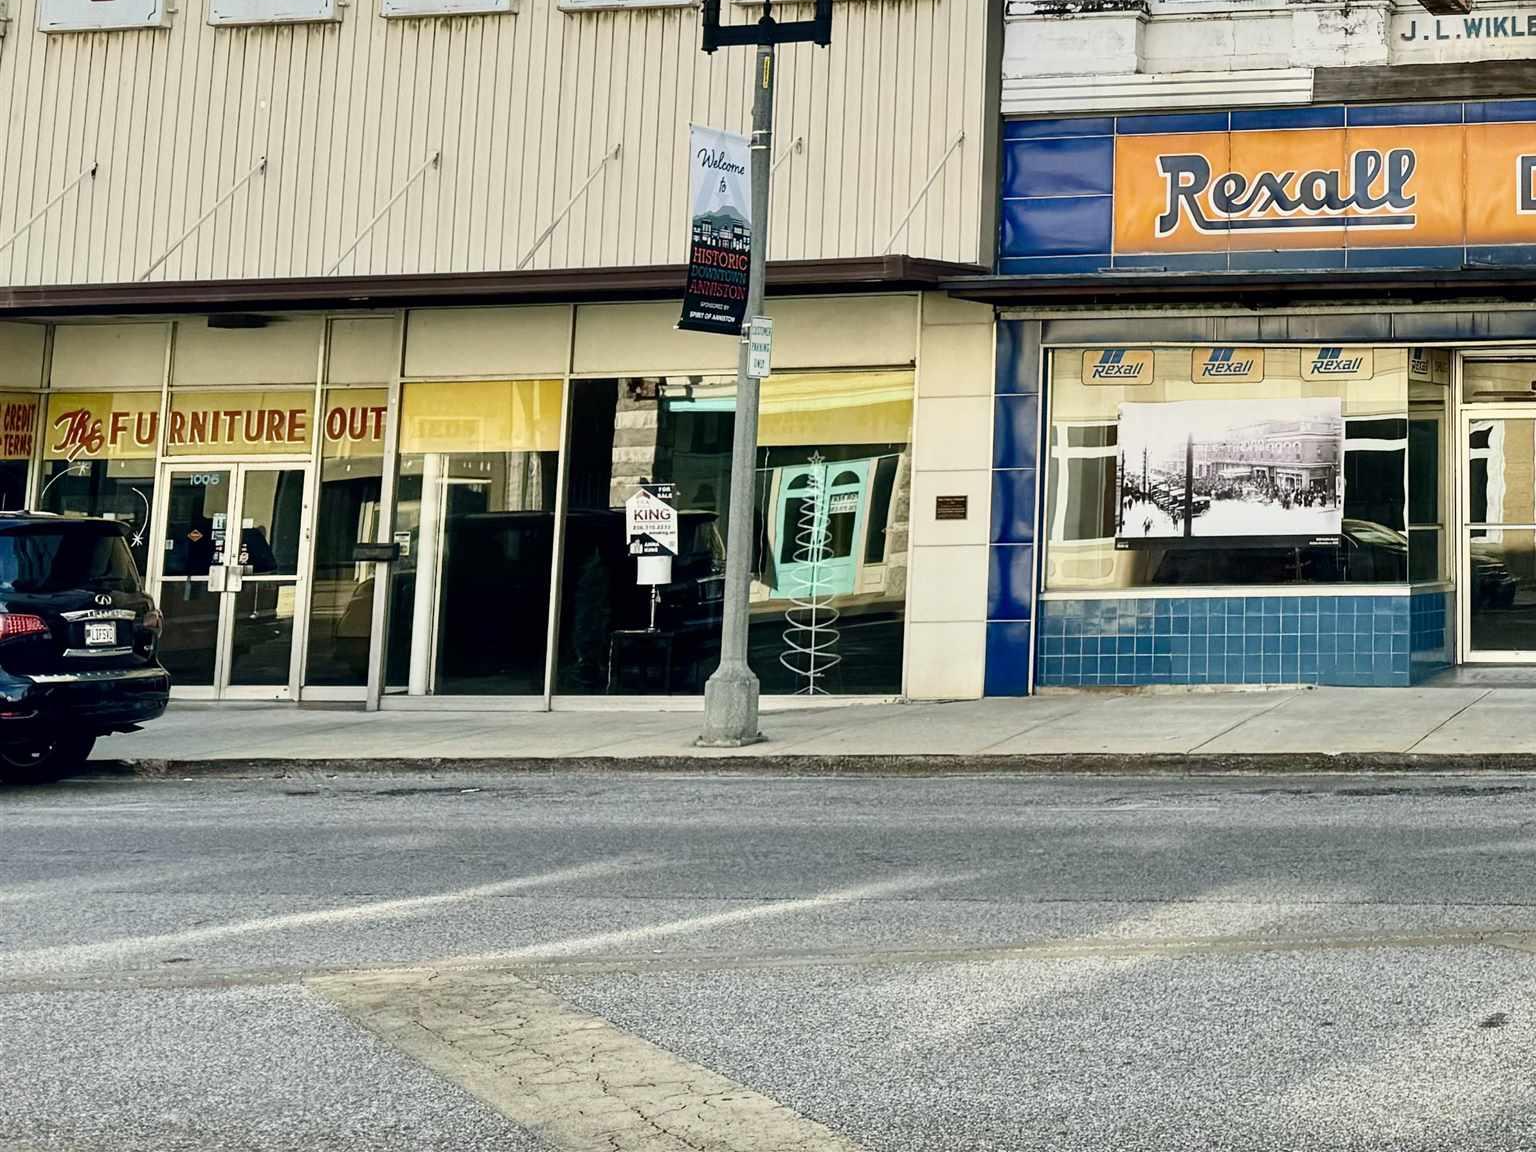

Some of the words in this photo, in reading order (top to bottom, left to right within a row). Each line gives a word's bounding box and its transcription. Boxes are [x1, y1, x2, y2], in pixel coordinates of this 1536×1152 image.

[697, 148, 744, 175] Welcome
[719, 177, 727, 192] to
[1156, 147, 1416, 238] Rexall
[692, 247, 749, 271] HISTORIC
[690, 265, 747, 285] DOWNTOWN
[688, 279, 746, 300] ANNISTON
[1092, 362, 1144, 378] Rexall
[1202, 359, 1254, 377] Rexall
[1311, 357, 1364, 374] Rexall
[3, 404, 36, 433] CREDIT
[52, 408, 105, 462] The
[108, 408, 306, 446] FURNITURE
[327, 406, 387, 441] OUT
[634, 508, 671, 520] KING
